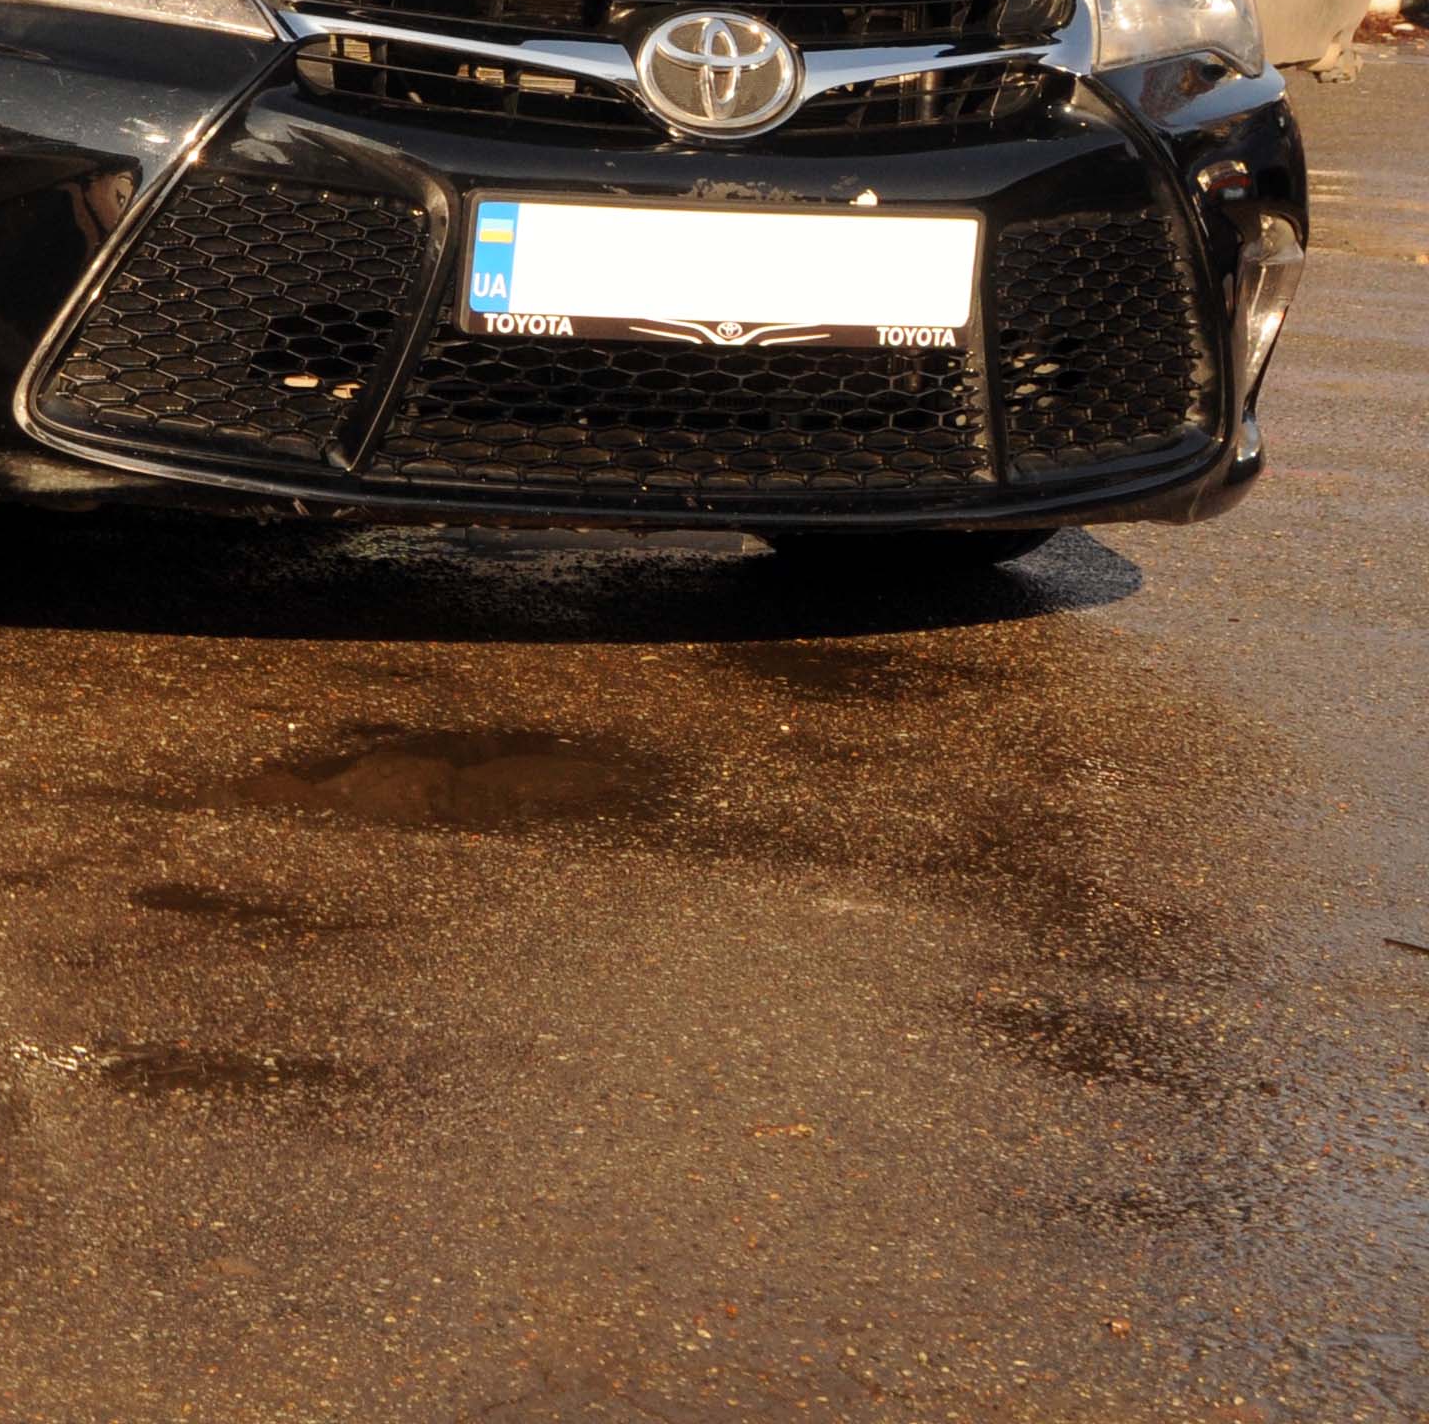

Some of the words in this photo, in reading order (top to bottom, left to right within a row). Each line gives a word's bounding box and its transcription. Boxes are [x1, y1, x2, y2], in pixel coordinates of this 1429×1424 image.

[473, 272, 508, 299] UA
[483, 313, 574, 337] TOYOTA
[876, 326, 957, 348] TOYOTA
